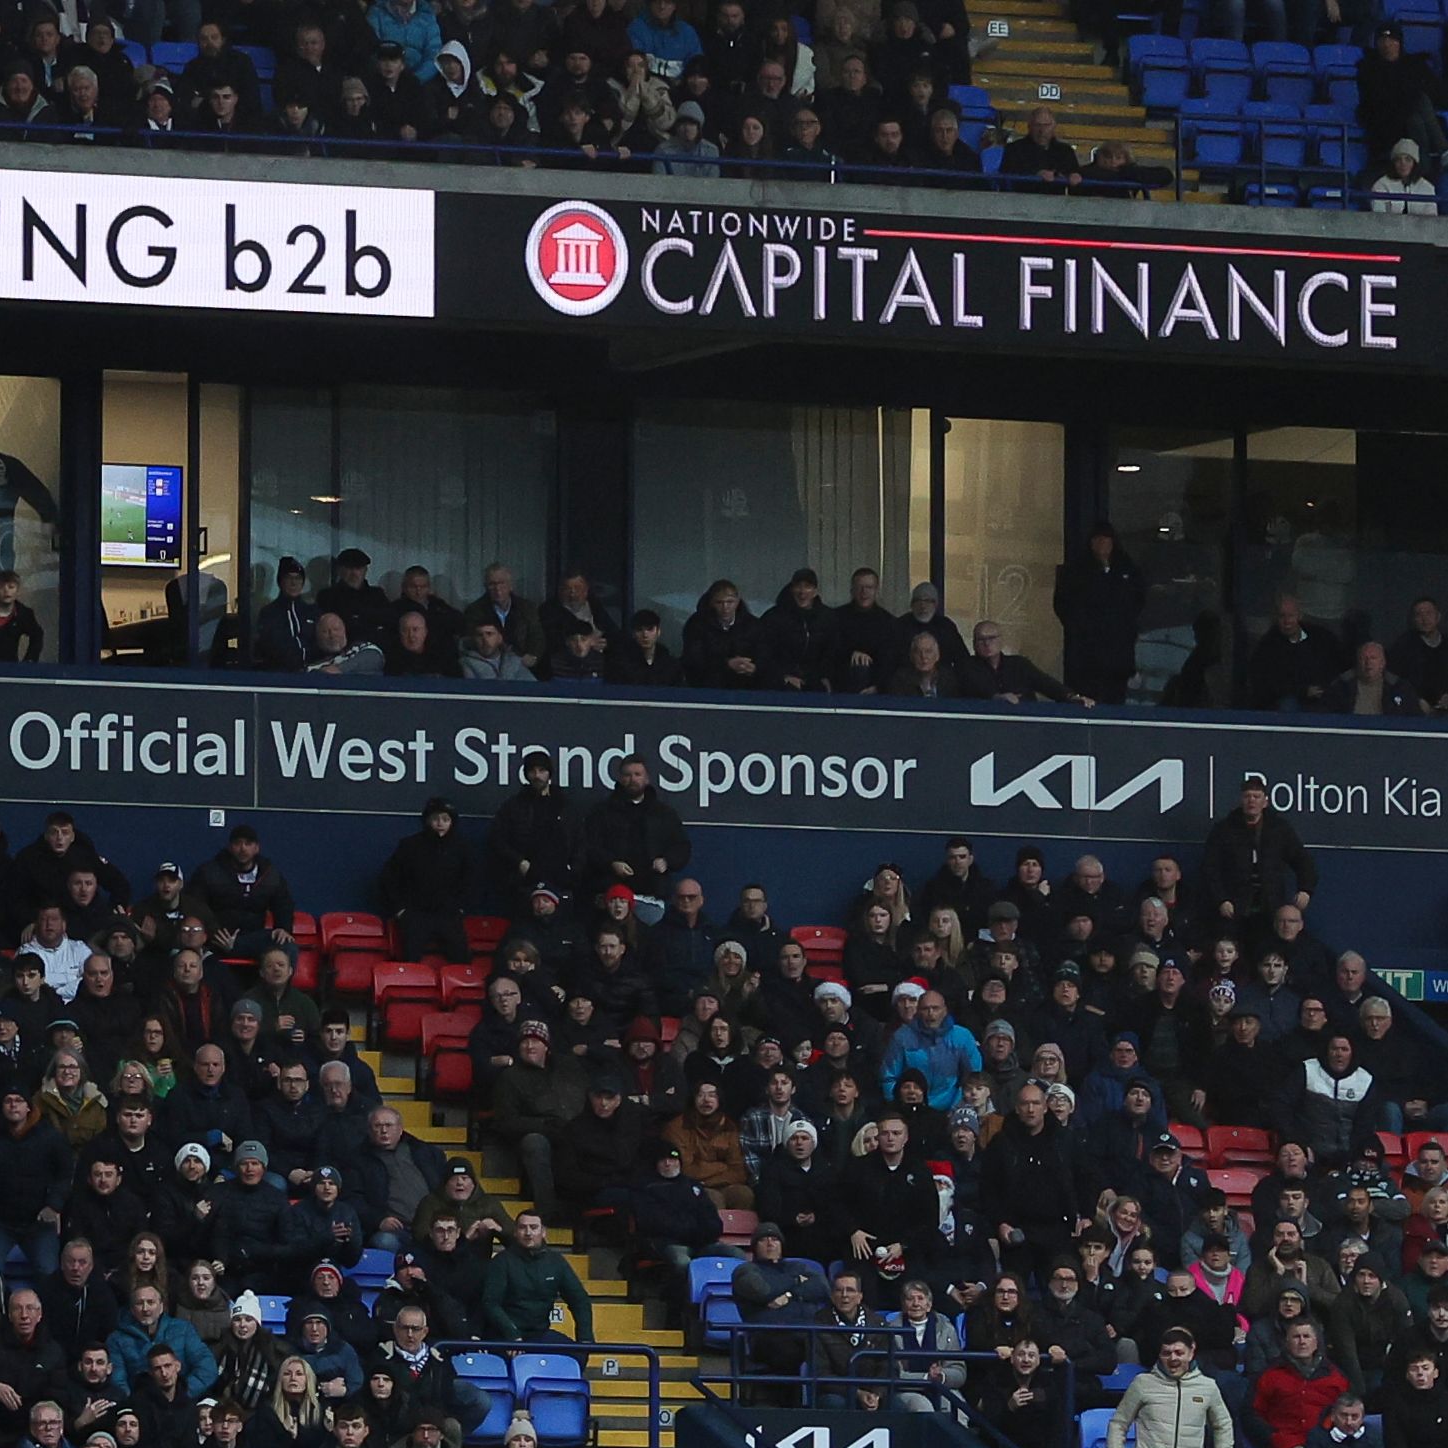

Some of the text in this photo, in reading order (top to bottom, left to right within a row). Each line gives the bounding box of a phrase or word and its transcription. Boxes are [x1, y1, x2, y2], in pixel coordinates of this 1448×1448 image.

[224, 205, 393, 301] b2b
[641, 207, 857, 243] NATIONWIDE
[641, 237, 1399, 351] CAPITAL FINANCE
[9, 710, 246, 776] Official
[270, 721, 432, 784] West
[658, 733, 917, 808] Sponsor
[972, 752, 1183, 812] KIA
[1384, 777, 1442, 817] Kia
[606, 1360, 616, 1374] P
